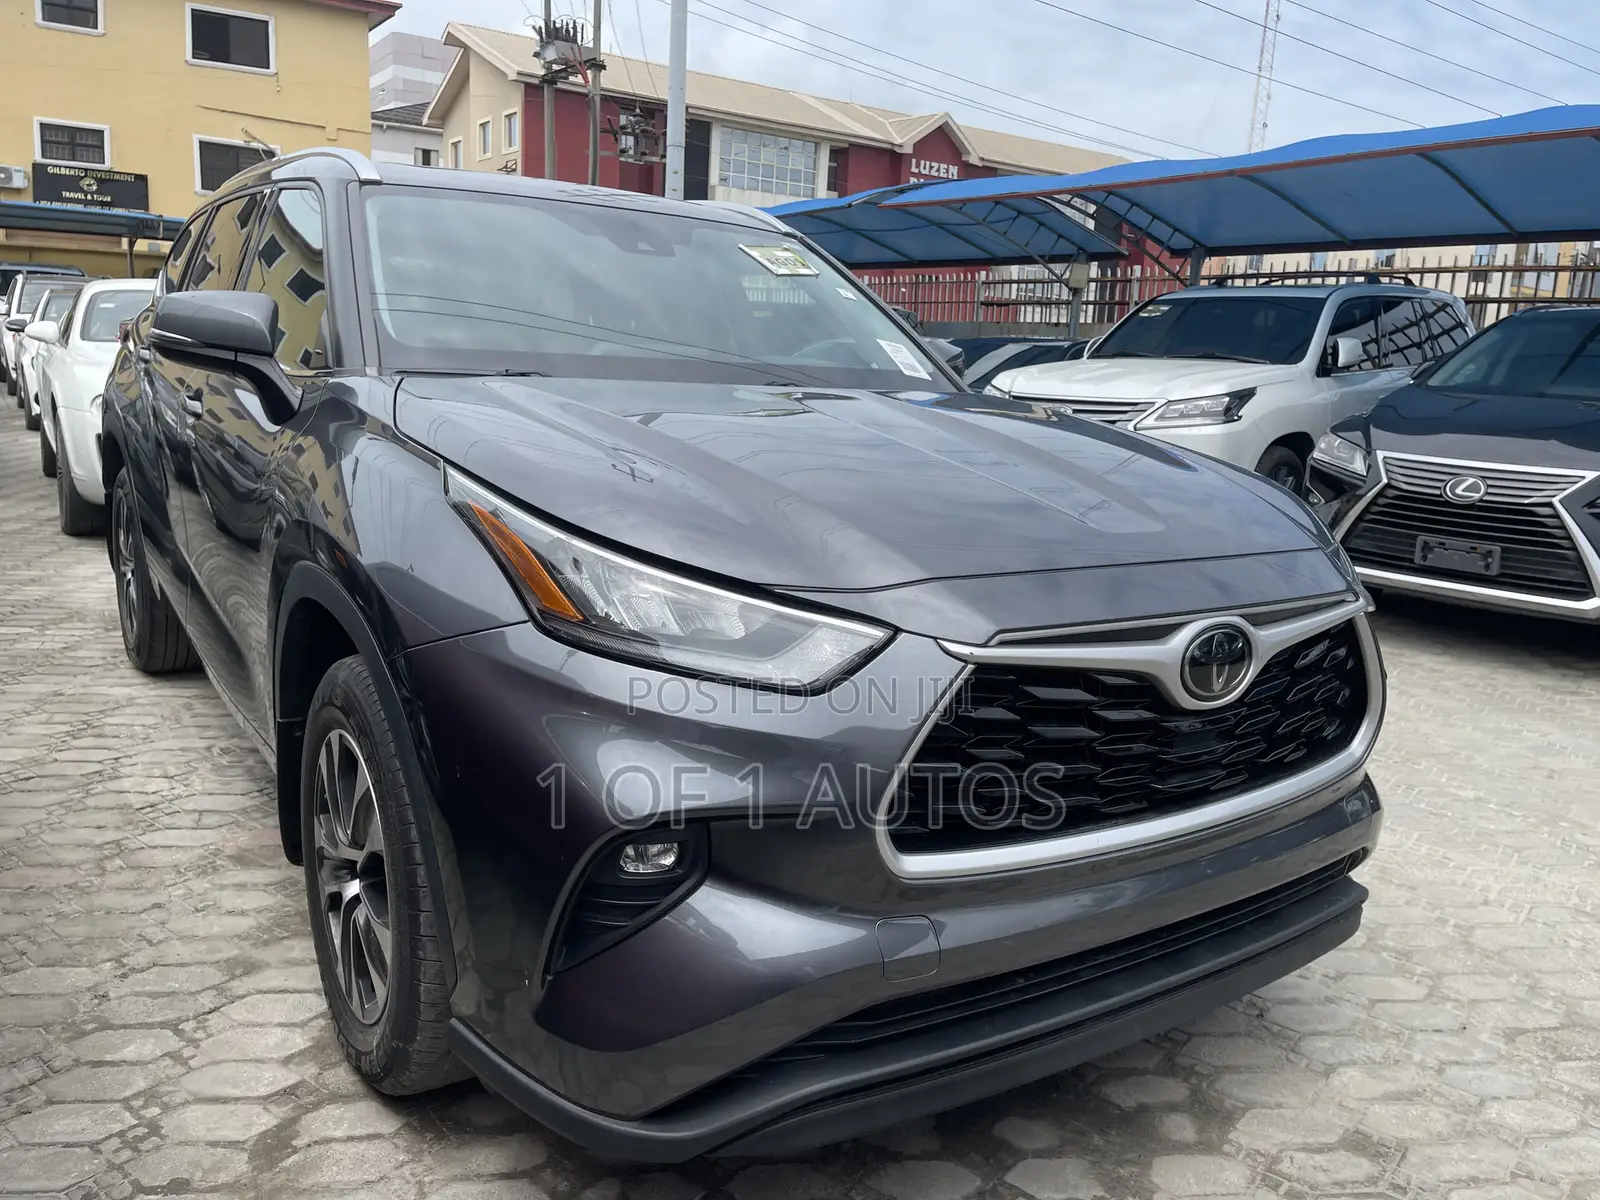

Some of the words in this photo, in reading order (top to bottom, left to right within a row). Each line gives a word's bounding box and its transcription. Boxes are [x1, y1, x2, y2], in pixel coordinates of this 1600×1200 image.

[47, 165, 86, 177] GILBERTO
[87, 169, 136, 182] INVESTMENT
[910, 158, 959, 179] LUZEN
[61, 190, 86, 200] TRAVEL
[93, 193, 112, 202] TOUR
